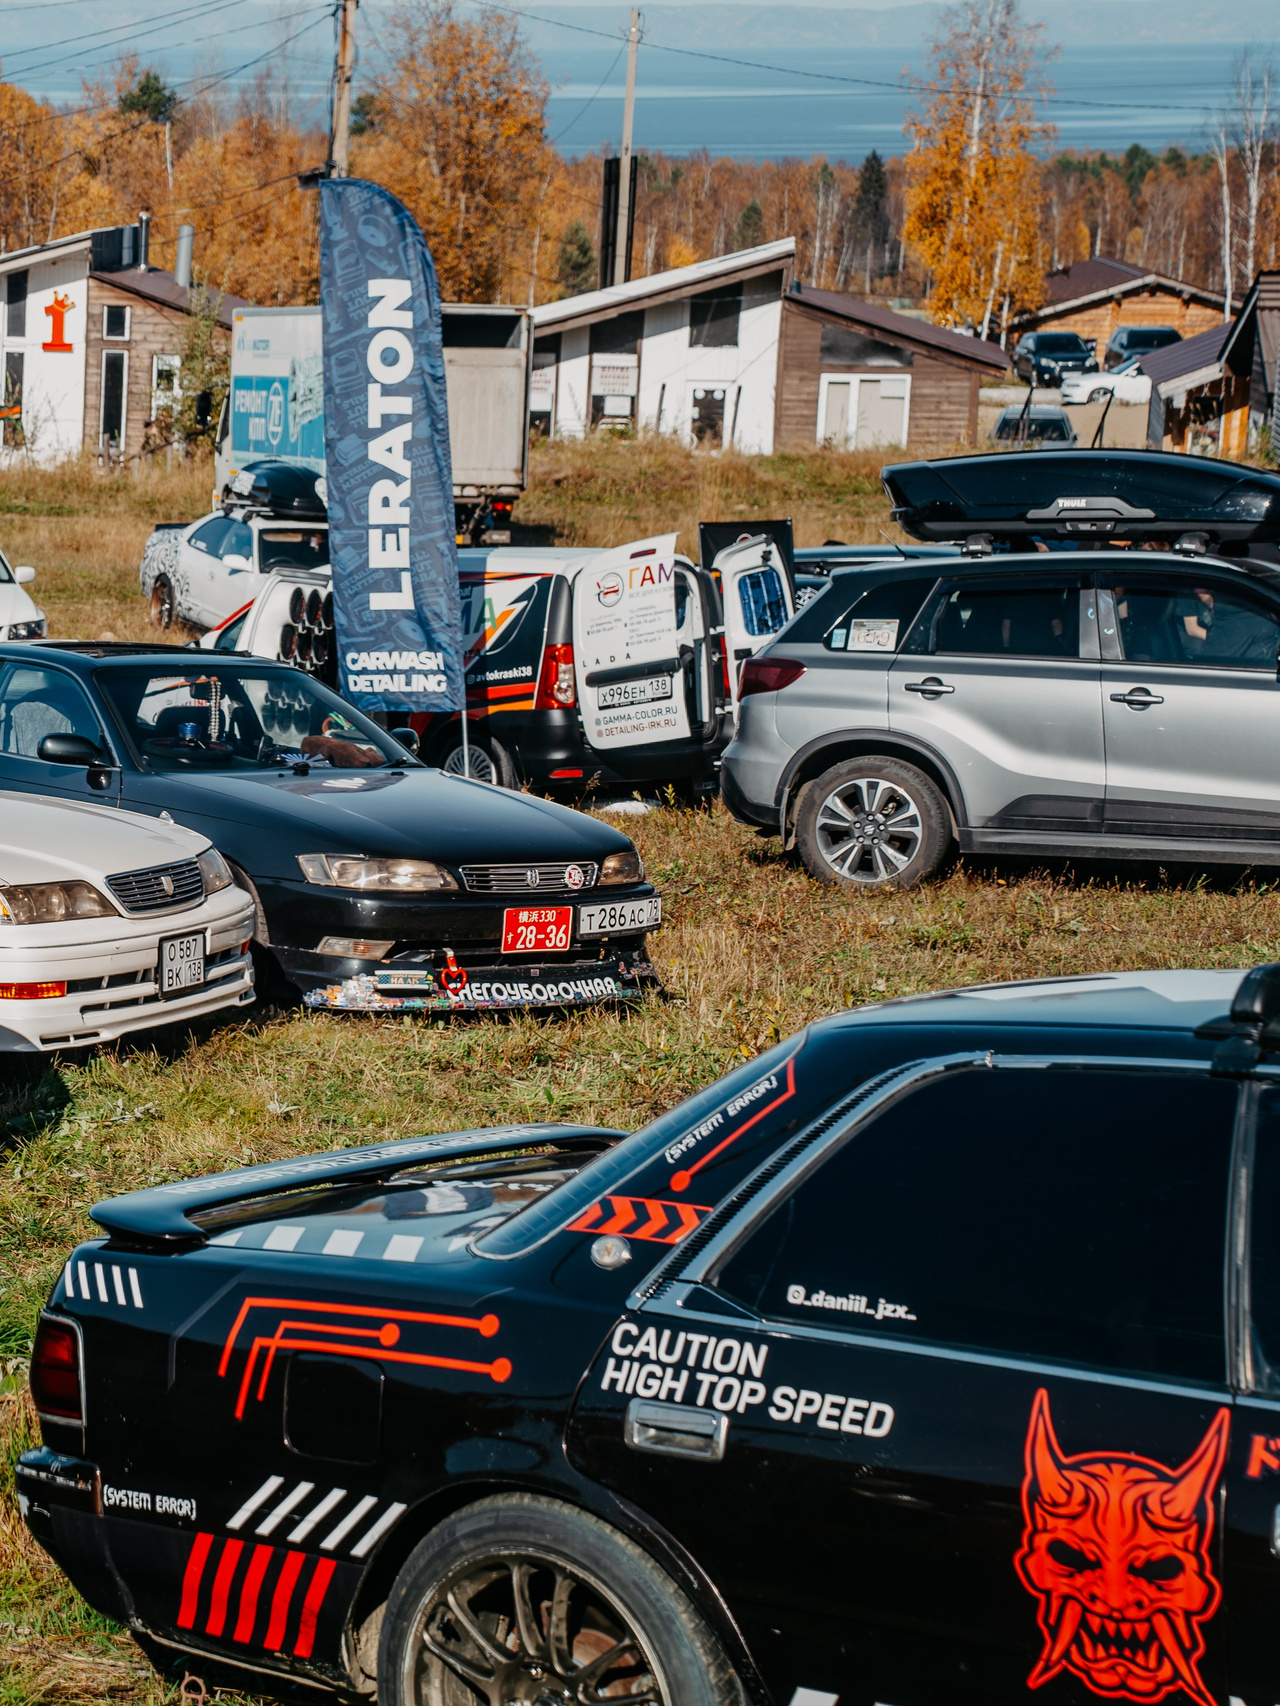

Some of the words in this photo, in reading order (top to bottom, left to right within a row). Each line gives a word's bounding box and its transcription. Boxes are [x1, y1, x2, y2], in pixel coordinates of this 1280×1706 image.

[235, 390, 267, 413] РЕМОНТ
[249, 417, 266, 440] КПП
[366, 278, 414, 610] LERATON
[1058, 499, 1087, 507] THULE
[346, 652, 444, 671] CARWASH
[582, 653, 632, 668] LADA
[348, 674, 447, 692] DETAILING
[476, 665, 533, 682] avtokraski38
[648, 679, 667, 693] 138
[603, 706, 678, 726] GAMMA-COLOR.RU
[605, 719, 677, 737] DETAILING-IRK.RU
[648, 900, 659, 917] 79
[516, 924, 567, 949] 28-36
[167, 966, 182, 988] ВК
[187, 961, 202, 978] 138
[611, 1322, 768, 1378] CAUTION
[600, 1357, 689, 1403] HIGH
[695, 1371, 766, 1414] TOP
[767, 1386, 895, 1438] SPEED
